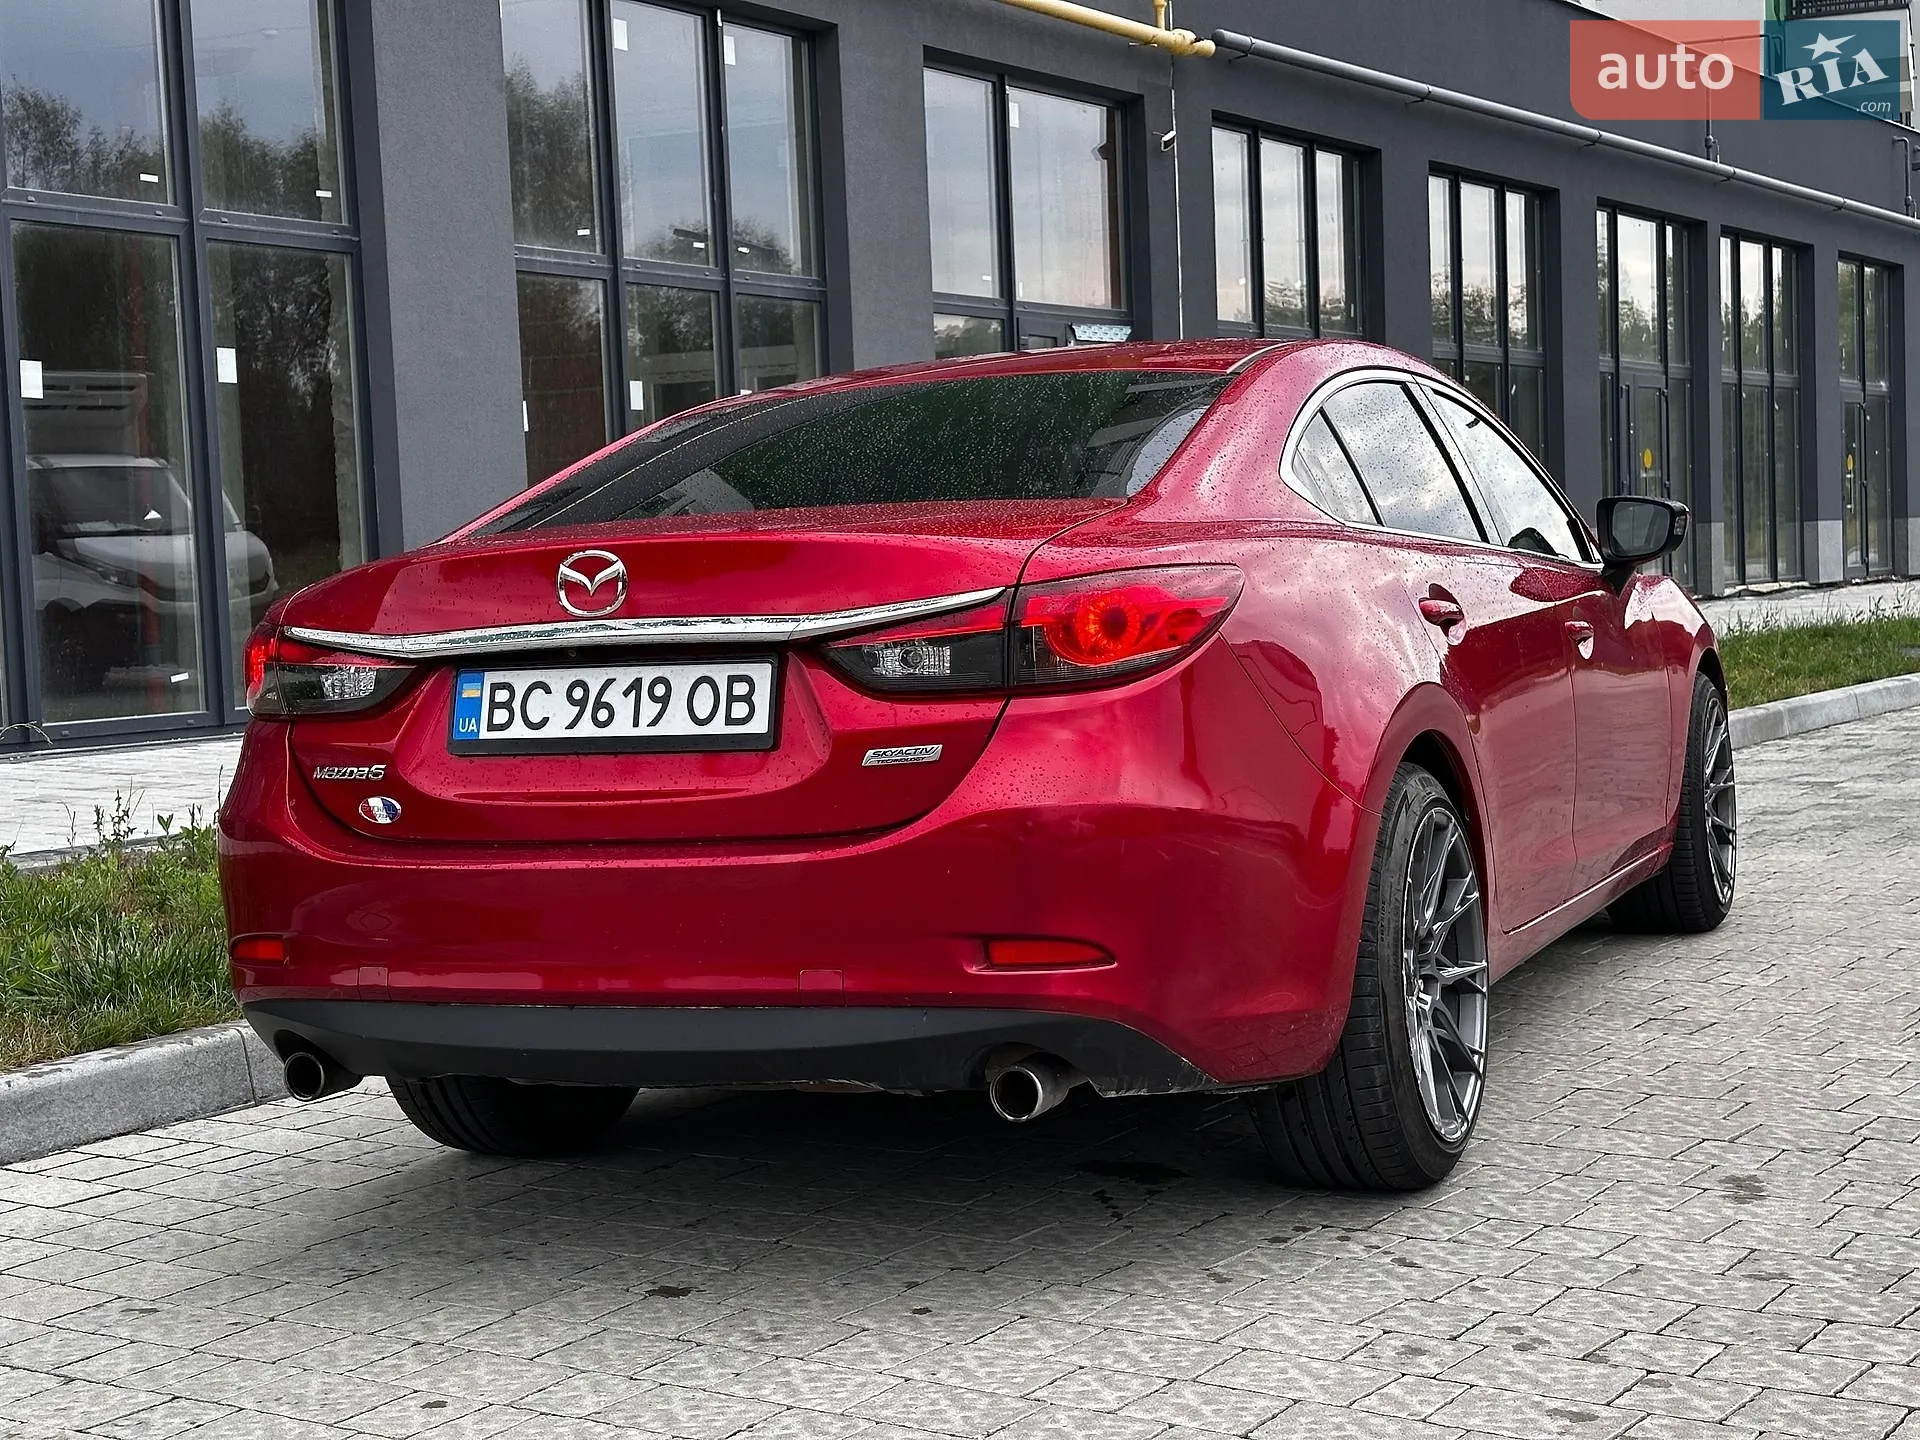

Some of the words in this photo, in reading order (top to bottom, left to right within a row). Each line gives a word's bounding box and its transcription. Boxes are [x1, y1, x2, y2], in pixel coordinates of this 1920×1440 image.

[486, 680, 552, 732] BC
[564, 676, 672, 730] 9619
[687, 674, 756, 727] OB
[459, 718, 478, 733] UA
[870, 746, 936, 758] SKYACTIV
